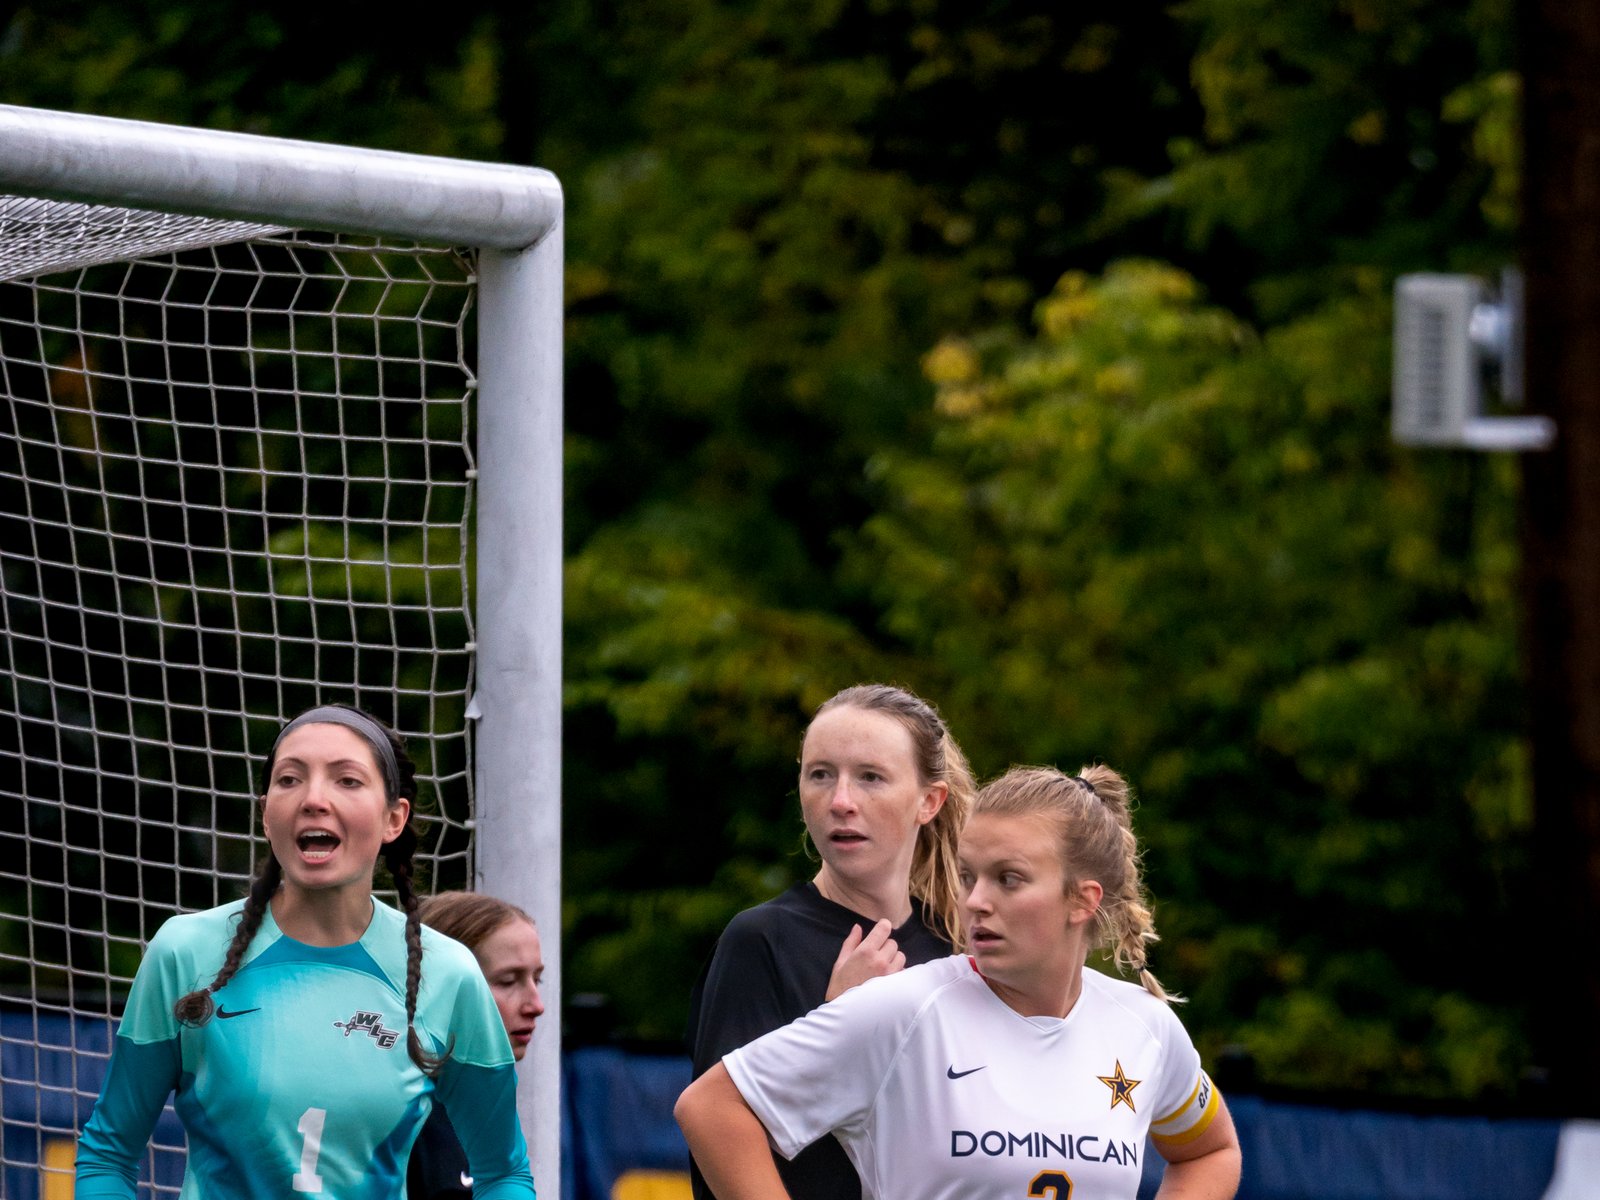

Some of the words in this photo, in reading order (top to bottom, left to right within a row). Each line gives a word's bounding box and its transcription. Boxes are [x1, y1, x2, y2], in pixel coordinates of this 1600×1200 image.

[355, 1010, 398, 1050] WLC
[292, 1107, 327, 1193] 1
[950, 1130, 1138, 1168] DOMINICAN
